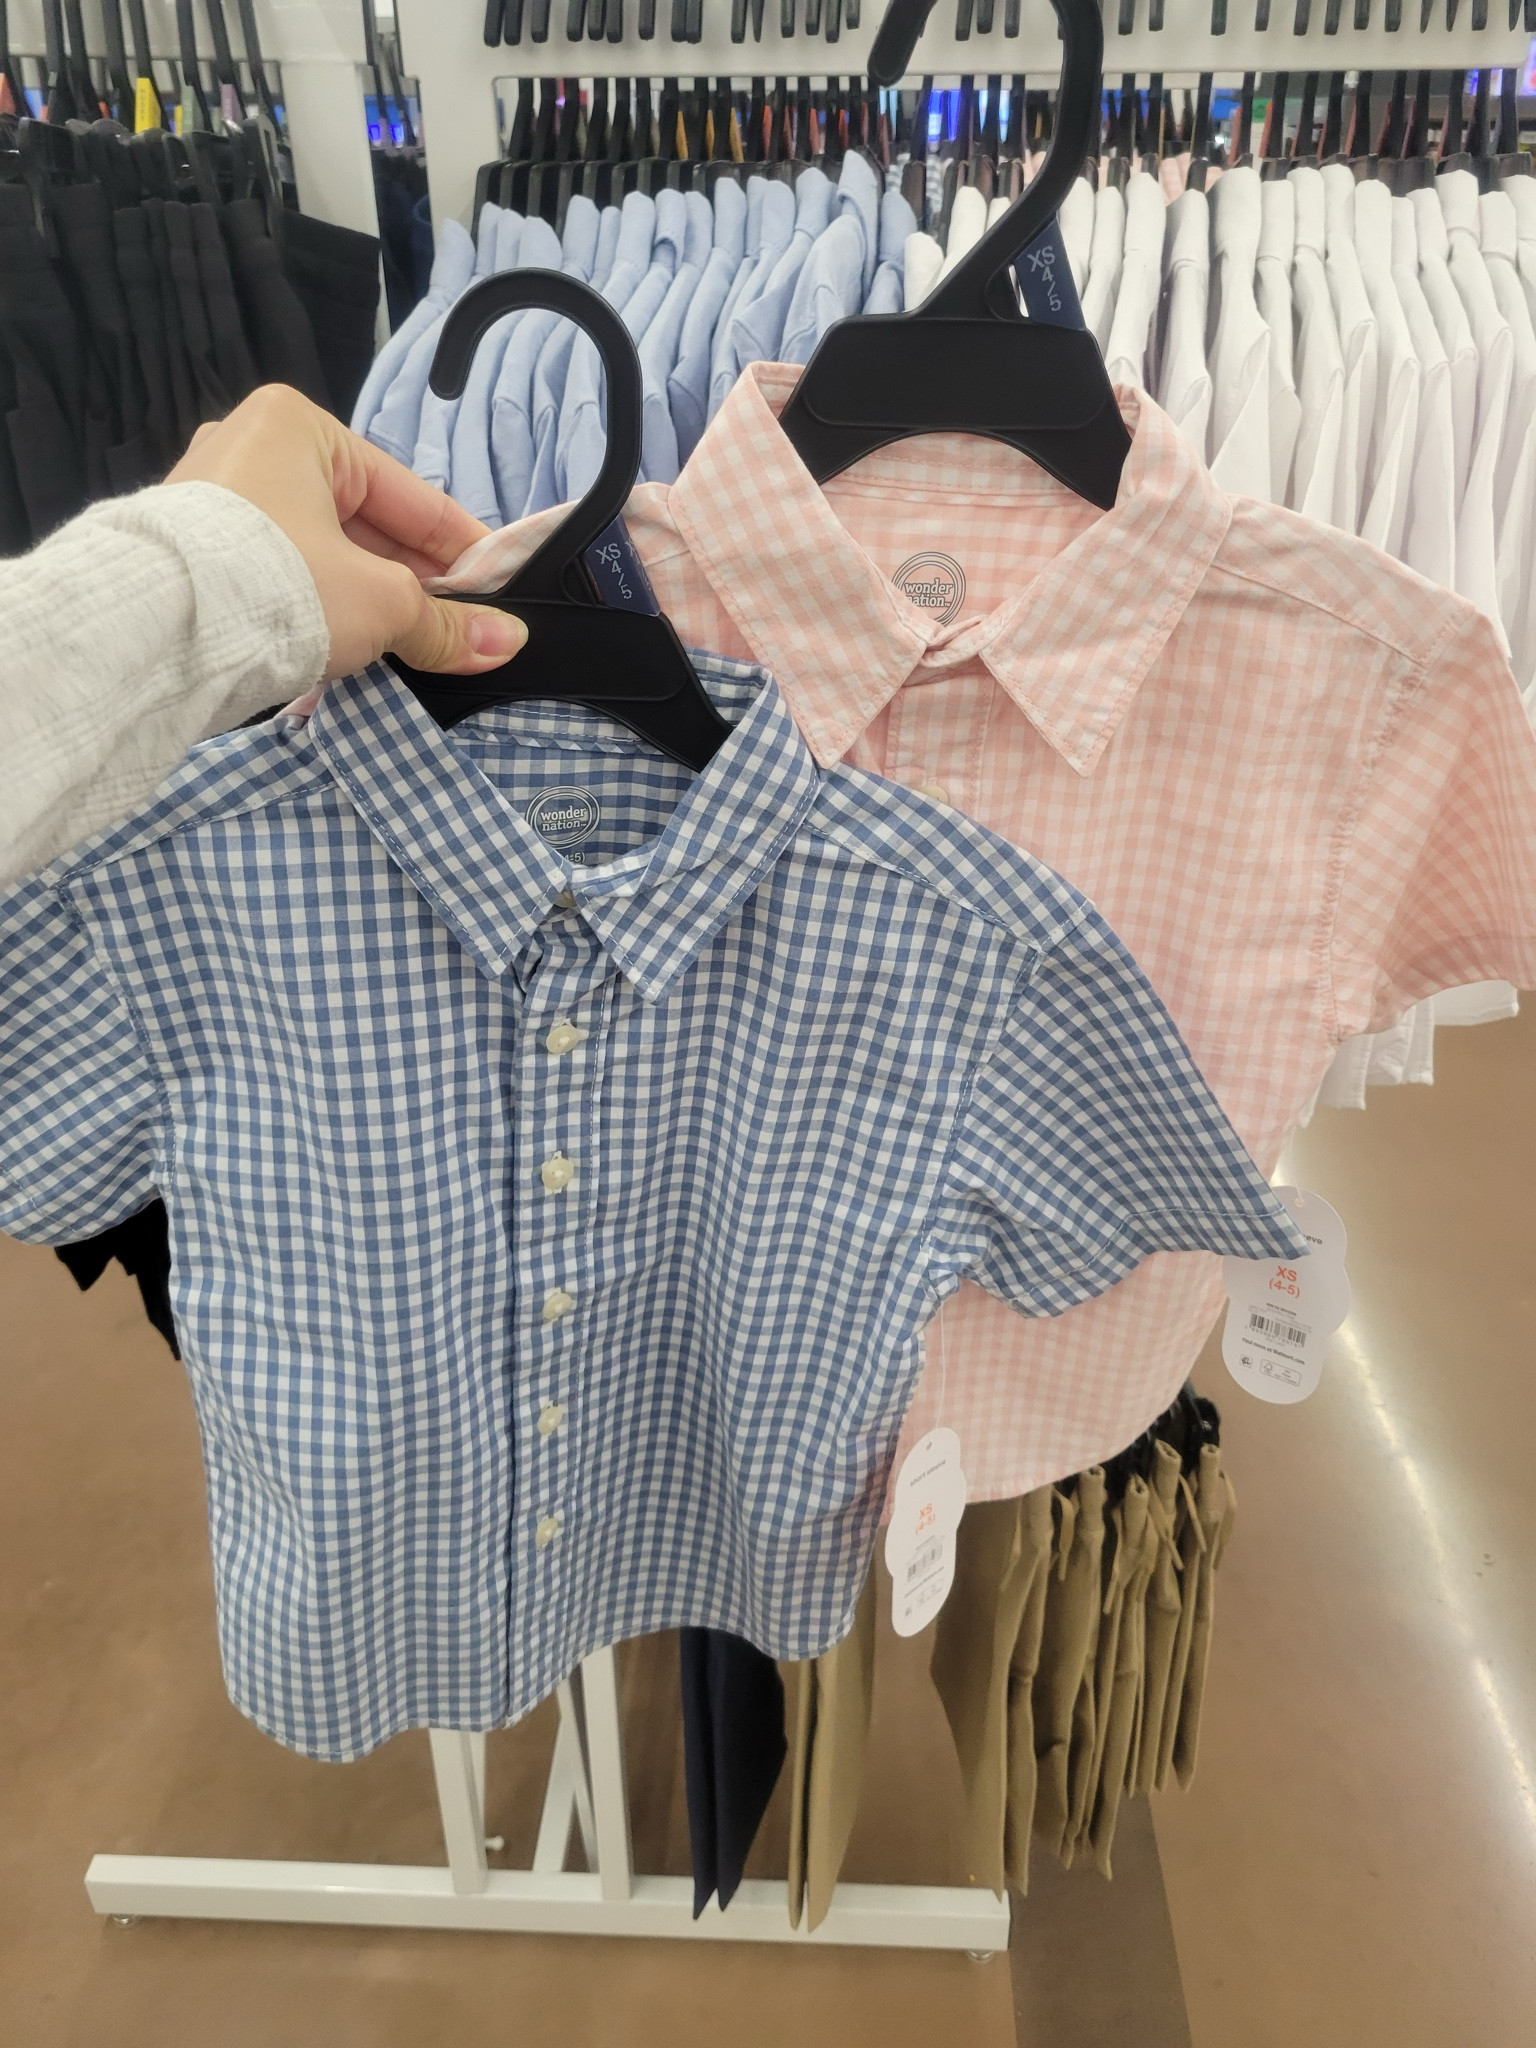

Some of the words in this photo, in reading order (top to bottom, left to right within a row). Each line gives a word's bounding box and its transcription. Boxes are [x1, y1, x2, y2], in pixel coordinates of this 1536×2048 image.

[1027, 245, 1056, 273] XS
[595, 543, 622, 565] XS
[904, 577, 954, 594] wonder
[540, 805, 587, 821] wonder
[542, 820, 581, 832] nation
[1276, 1265, 1297, 1282] XS
[1269, 1278, 1300, 1299] (4-5)
[919, 1502, 933, 1520] XS
